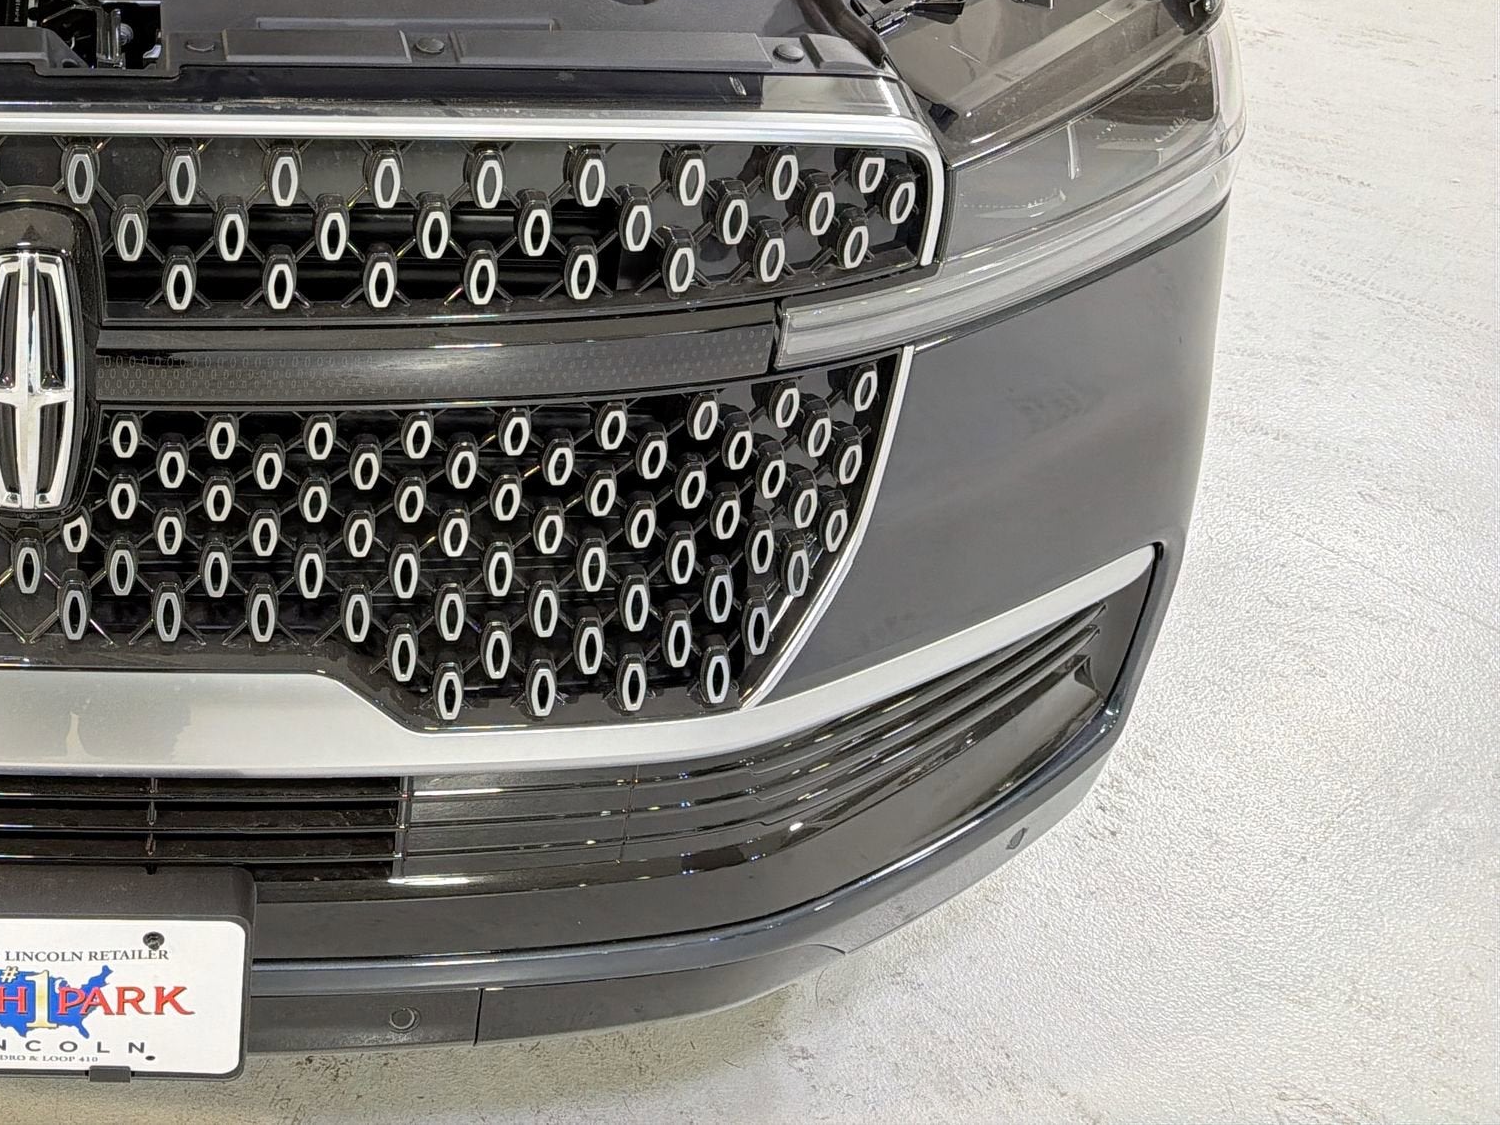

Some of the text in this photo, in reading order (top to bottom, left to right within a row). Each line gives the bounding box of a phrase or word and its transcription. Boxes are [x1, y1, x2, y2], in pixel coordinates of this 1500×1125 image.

[4, 950, 84, 962] LINCOLN
[88, 949, 170, 961] RETAILER
[56, 985, 196, 1016] PARK
[41, 1055, 76, 1063] LOOP
[78, 1055, 99, 1063] 410
